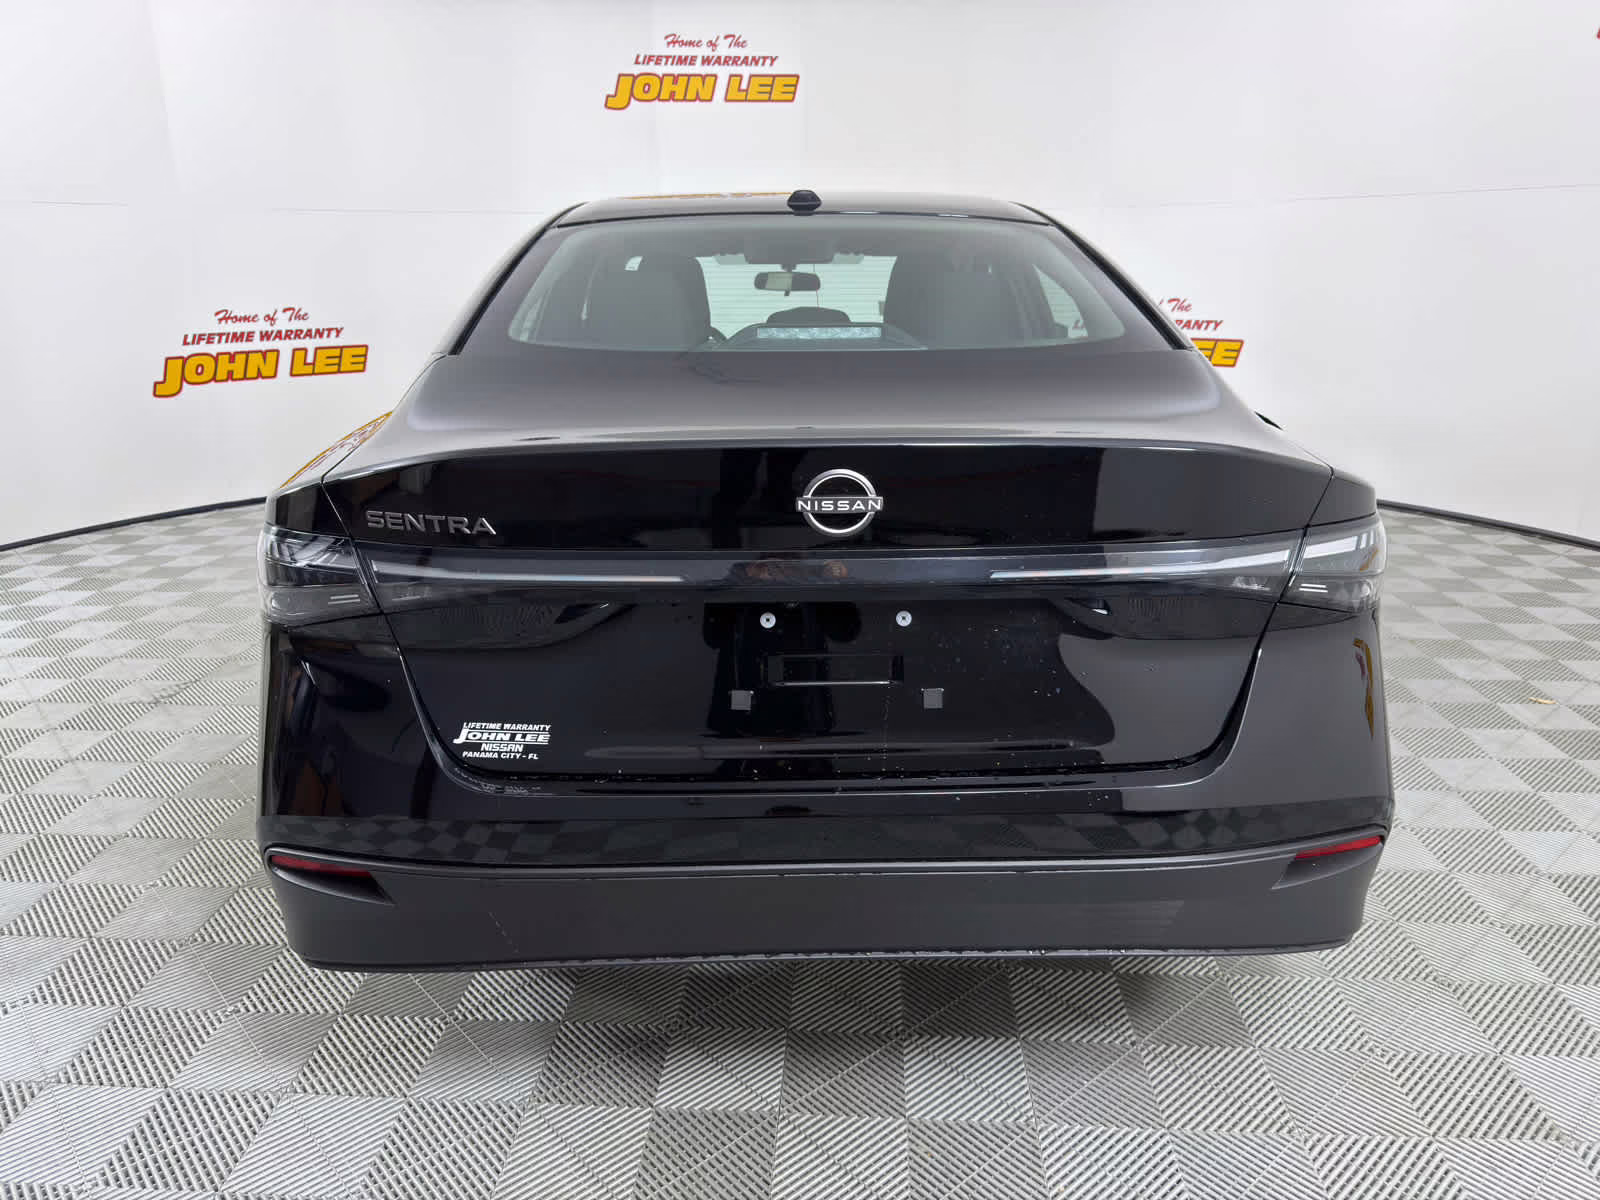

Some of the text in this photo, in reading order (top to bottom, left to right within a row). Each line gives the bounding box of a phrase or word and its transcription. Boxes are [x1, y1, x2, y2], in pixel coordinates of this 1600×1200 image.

[664, 33, 748, 52] Home of The
[634, 54, 779, 67] LIFETIME WARRANTY
[604, 72, 800, 110] JOHN LEE
[1167, 298, 1192, 312] The
[214, 307, 310, 326] Home of The
[182, 327, 344, 346] LIFETIME WARRANTY
[153, 344, 369, 398] JOHN LEE
[798, 500, 881, 511] NISSAN
[365, 510, 497, 535] SENTRA
[463, 722, 551, 731] LIFETIME WARRANTY
[453, 728, 551, 744] JOHN LEE
[462, 751, 499, 759] PANAMA
[500, 752, 522, 760] CITY
[481, 743, 524, 752] NISSAN
